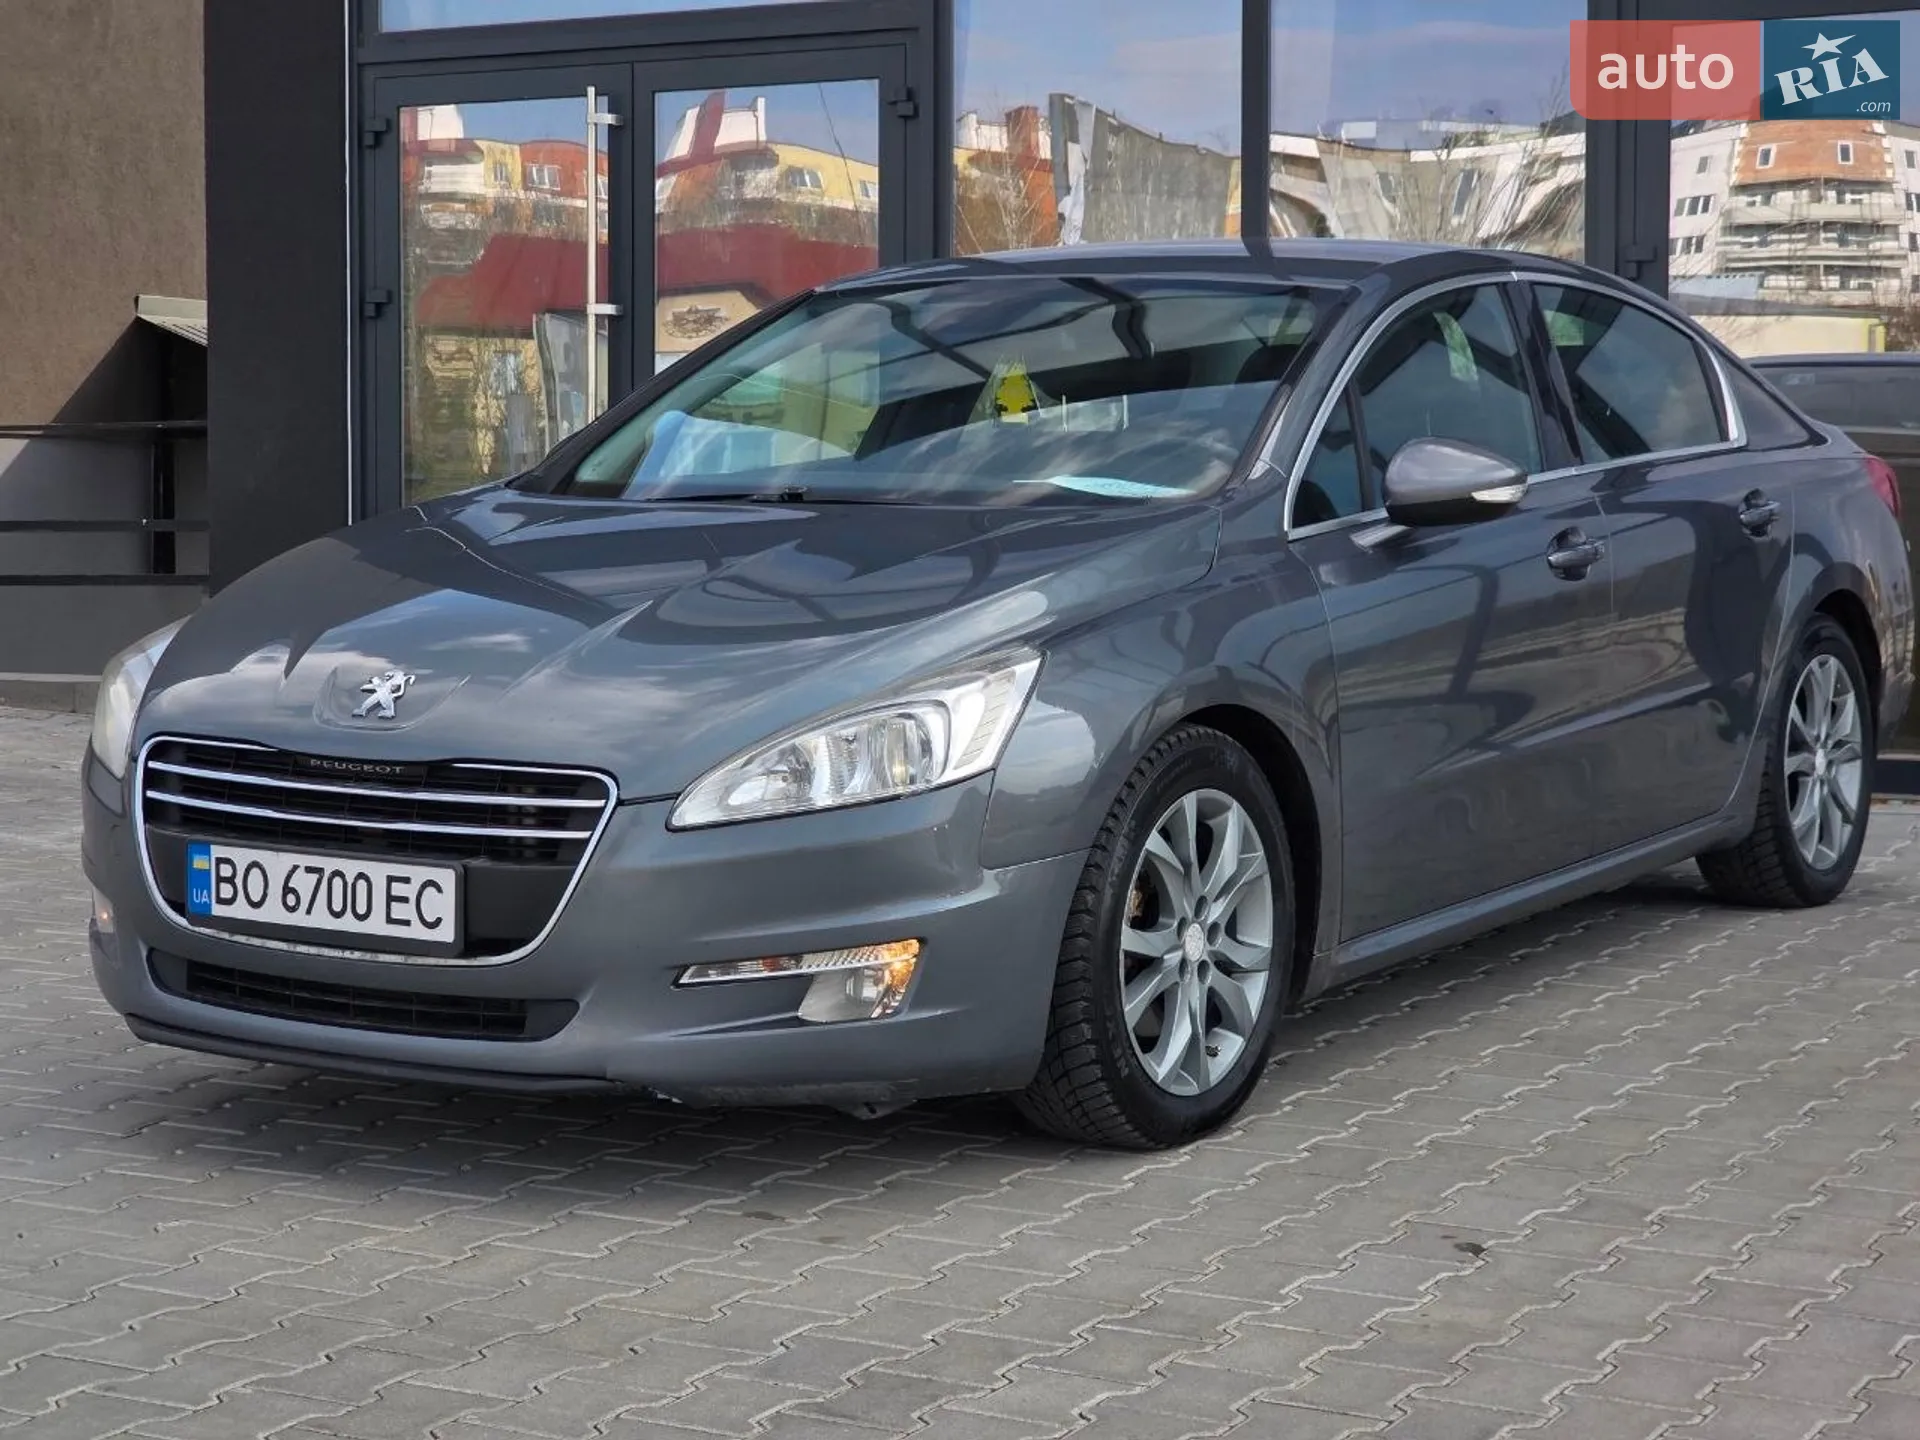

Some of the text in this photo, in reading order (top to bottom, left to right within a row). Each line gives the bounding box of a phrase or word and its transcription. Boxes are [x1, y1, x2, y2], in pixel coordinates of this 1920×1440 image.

[310, 759, 405, 774] PEUGEOT
[193, 888, 210, 905] UA
[214, 856, 444, 930] BO 6700 EC
